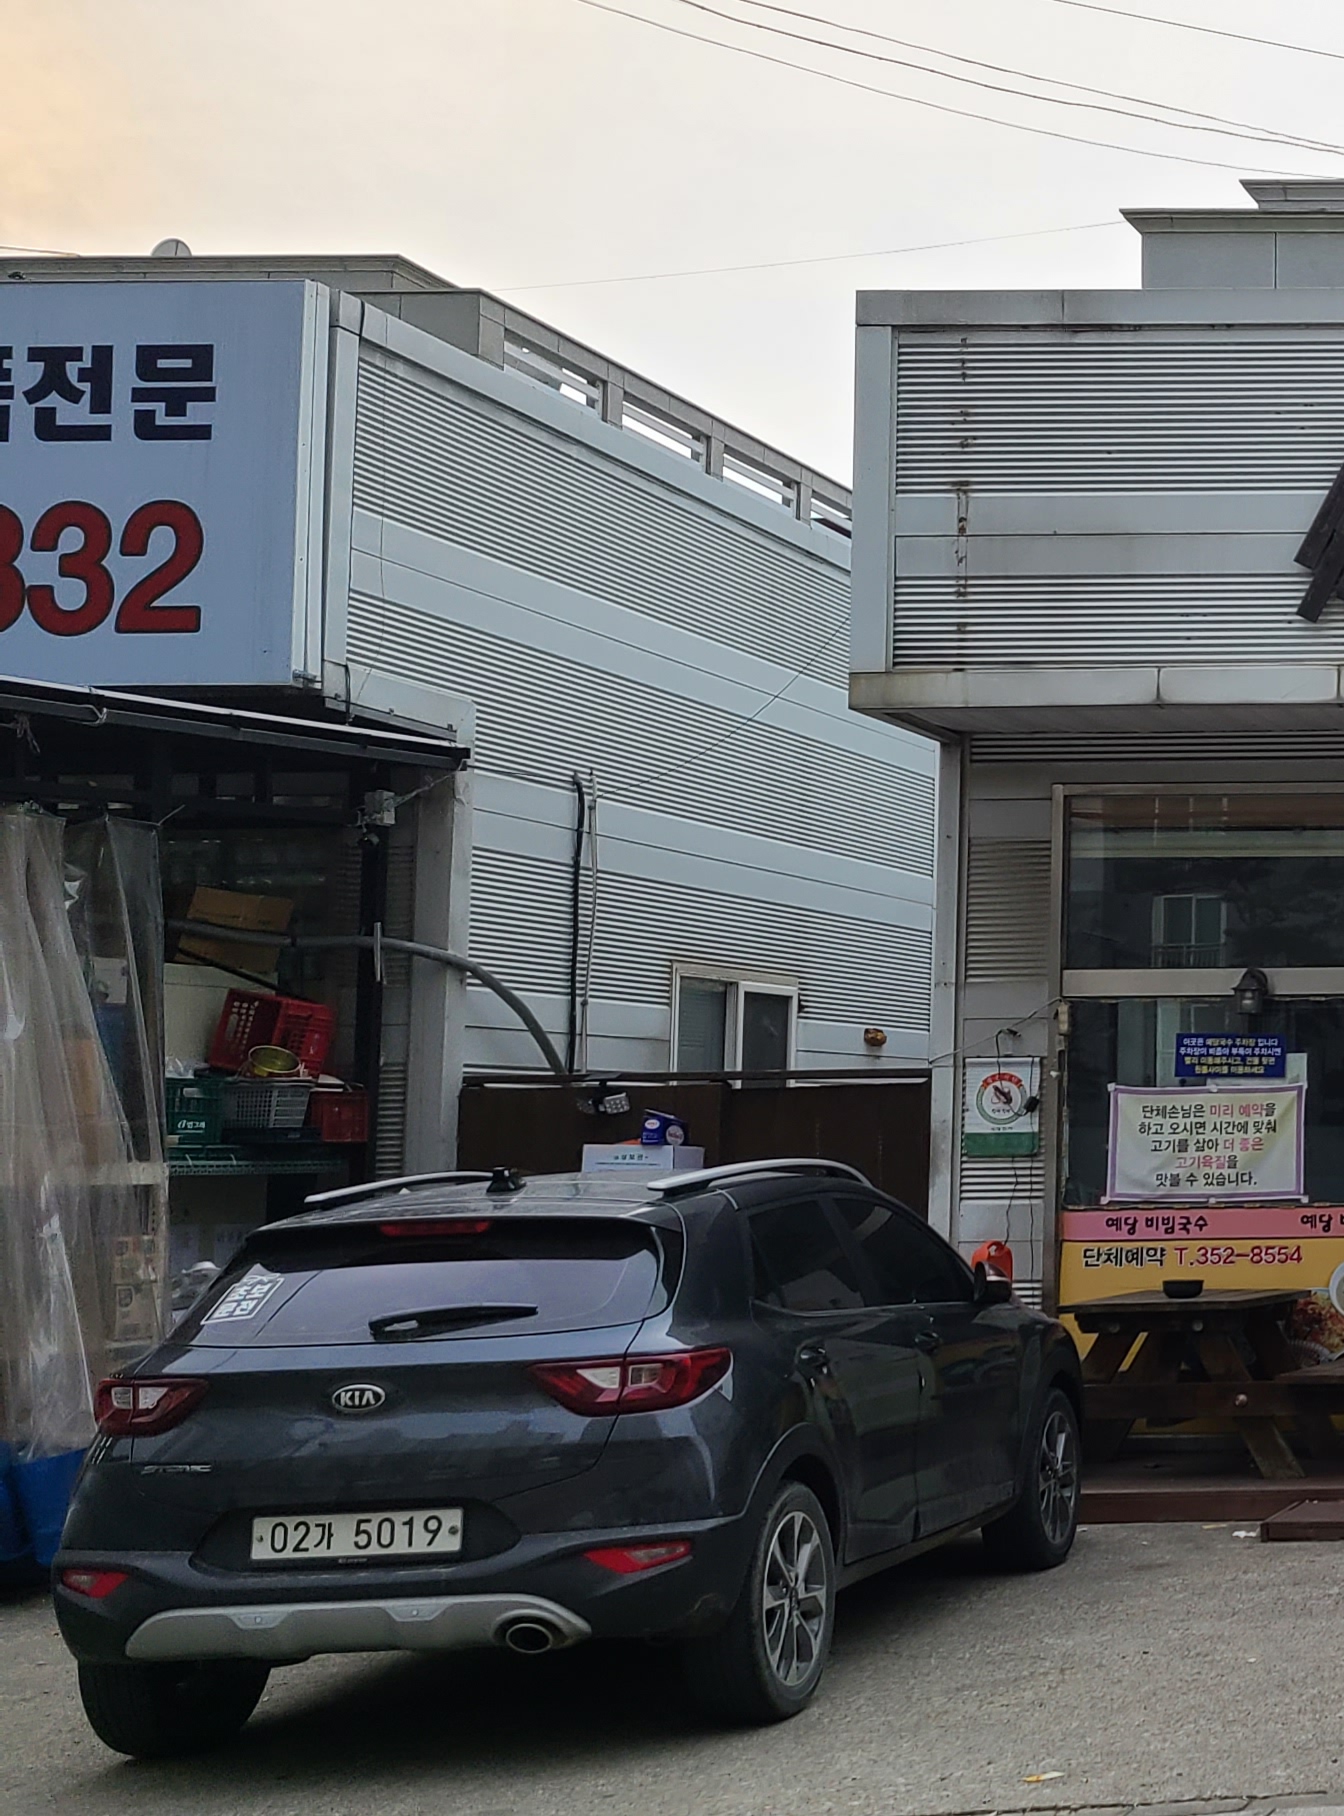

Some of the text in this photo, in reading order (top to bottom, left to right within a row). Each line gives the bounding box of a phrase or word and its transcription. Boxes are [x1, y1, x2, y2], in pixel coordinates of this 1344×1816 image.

[0, 344, 216, 441] 전문
[0, 500, 204, 636] 32
[1142, 1102, 1276, 1119] 단체손님은 미리 예약을
[1138, 1119, 1277, 1136] 하고 오시면 시간에 맞춰
[1151, 1137, 1264, 1152] 고기를 삶아 더 좋은
[1175, 1155, 1238, 1169] 고기육질을
[1156, 1171, 1257, 1187] 맛볼 수 있습니다.
[1105, 1215, 1209, 1235] 예당 비빔국수
[1300, 1213, 1332, 1232] 예당
[1083, 1245, 1303, 1268] 단체예약 T.352-8554
[340, 1391, 376, 1406] KIA
[269, 1514, 443, 1554] 02가 5019
